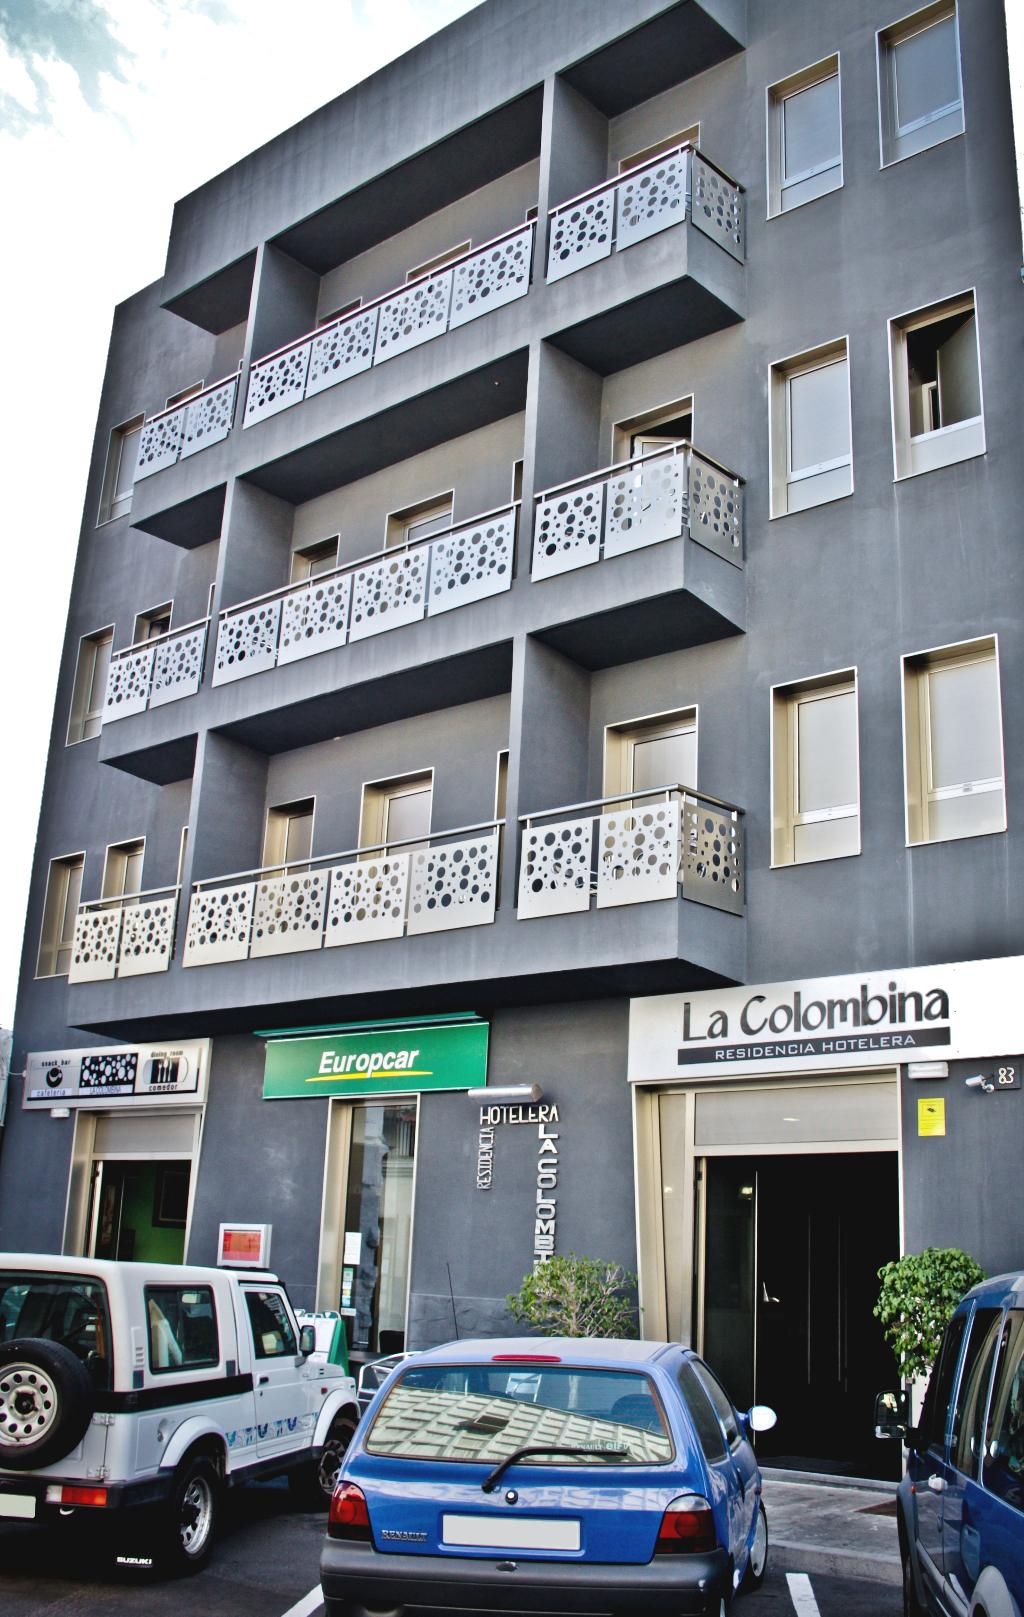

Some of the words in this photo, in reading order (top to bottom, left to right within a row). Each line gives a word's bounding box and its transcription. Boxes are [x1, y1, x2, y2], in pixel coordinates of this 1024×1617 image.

[683, 1002, 729, 1042] La
[740, 981, 950, 1036] Colombina
[715, 1043, 815, 1060] RESIDENCIA
[822, 1034, 916, 1053] HOTELERA
[318, 1049, 420, 1079] Europcar
[998, 1067, 1015, 1084] 83
[148, 1083, 178, 1092] comedor
[479, 1104, 559, 1125] HOTELERA
[538, 1124, 559, 1154] LA
[477, 1126, 495, 1190] RESIDENCIA
[533, 1158, 558, 1278] COLOMBI
[381, 1529, 428, 1541] RENAULT
[116, 1556, 153, 1565] SUZUKI
